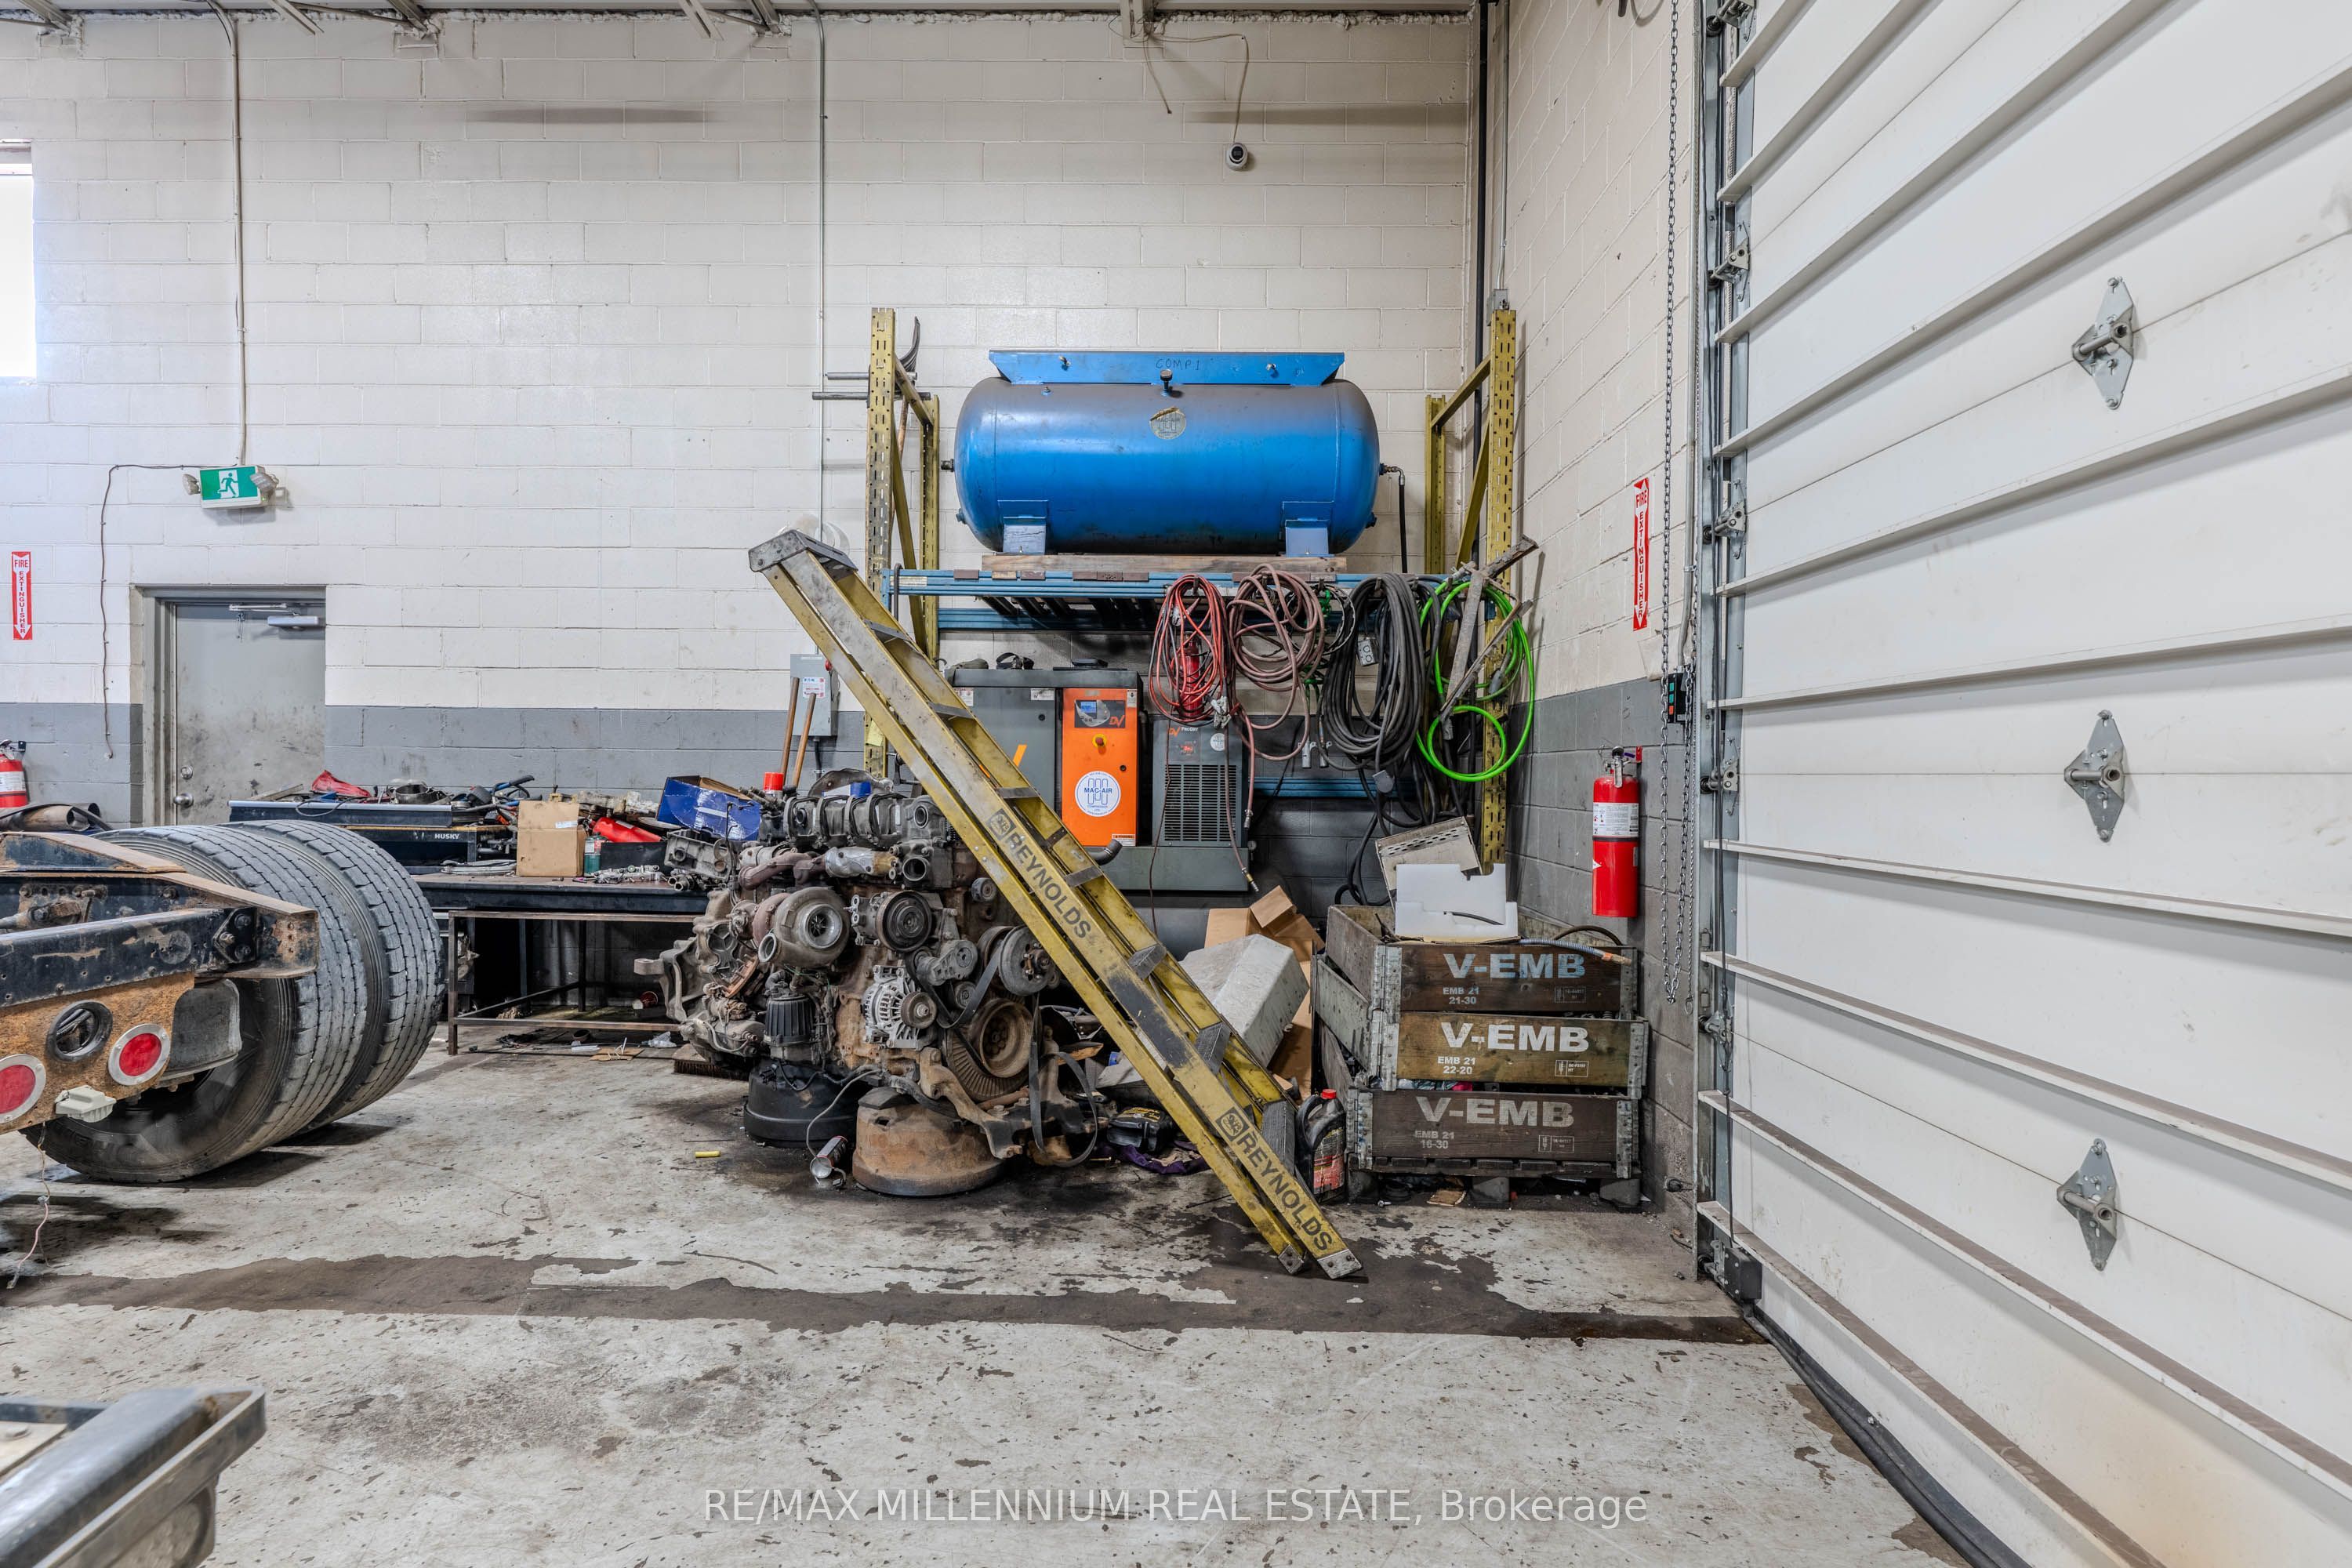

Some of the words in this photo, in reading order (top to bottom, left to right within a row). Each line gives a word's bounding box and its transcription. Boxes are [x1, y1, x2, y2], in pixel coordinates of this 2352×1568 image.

[1635, 490, 1647, 508] FIRE
[14, 559, 28, 568] FIRE
[1004, 832, 1091, 938] REYNOLDS
[1443, 953, 1586, 978] V-EMB
[1468, 986, 1479, 995] 21
[1448, 996, 1477, 1005] 21-30
[1441, 1022, 1589, 1052] V-EMB
[1437, 1056, 1461, 1065] EMB
[1443, 1065, 1473, 1075] 22-20
[1416, 1096, 1574, 1127] V-EMB
[1414, 1130, 1439, 1139] EMB
[1443, 1131, 1455, 1140] 21
[1420, 1140, 1449, 1149] 16-30
[1236, 1132, 1333, 1250] REYNOLDS
